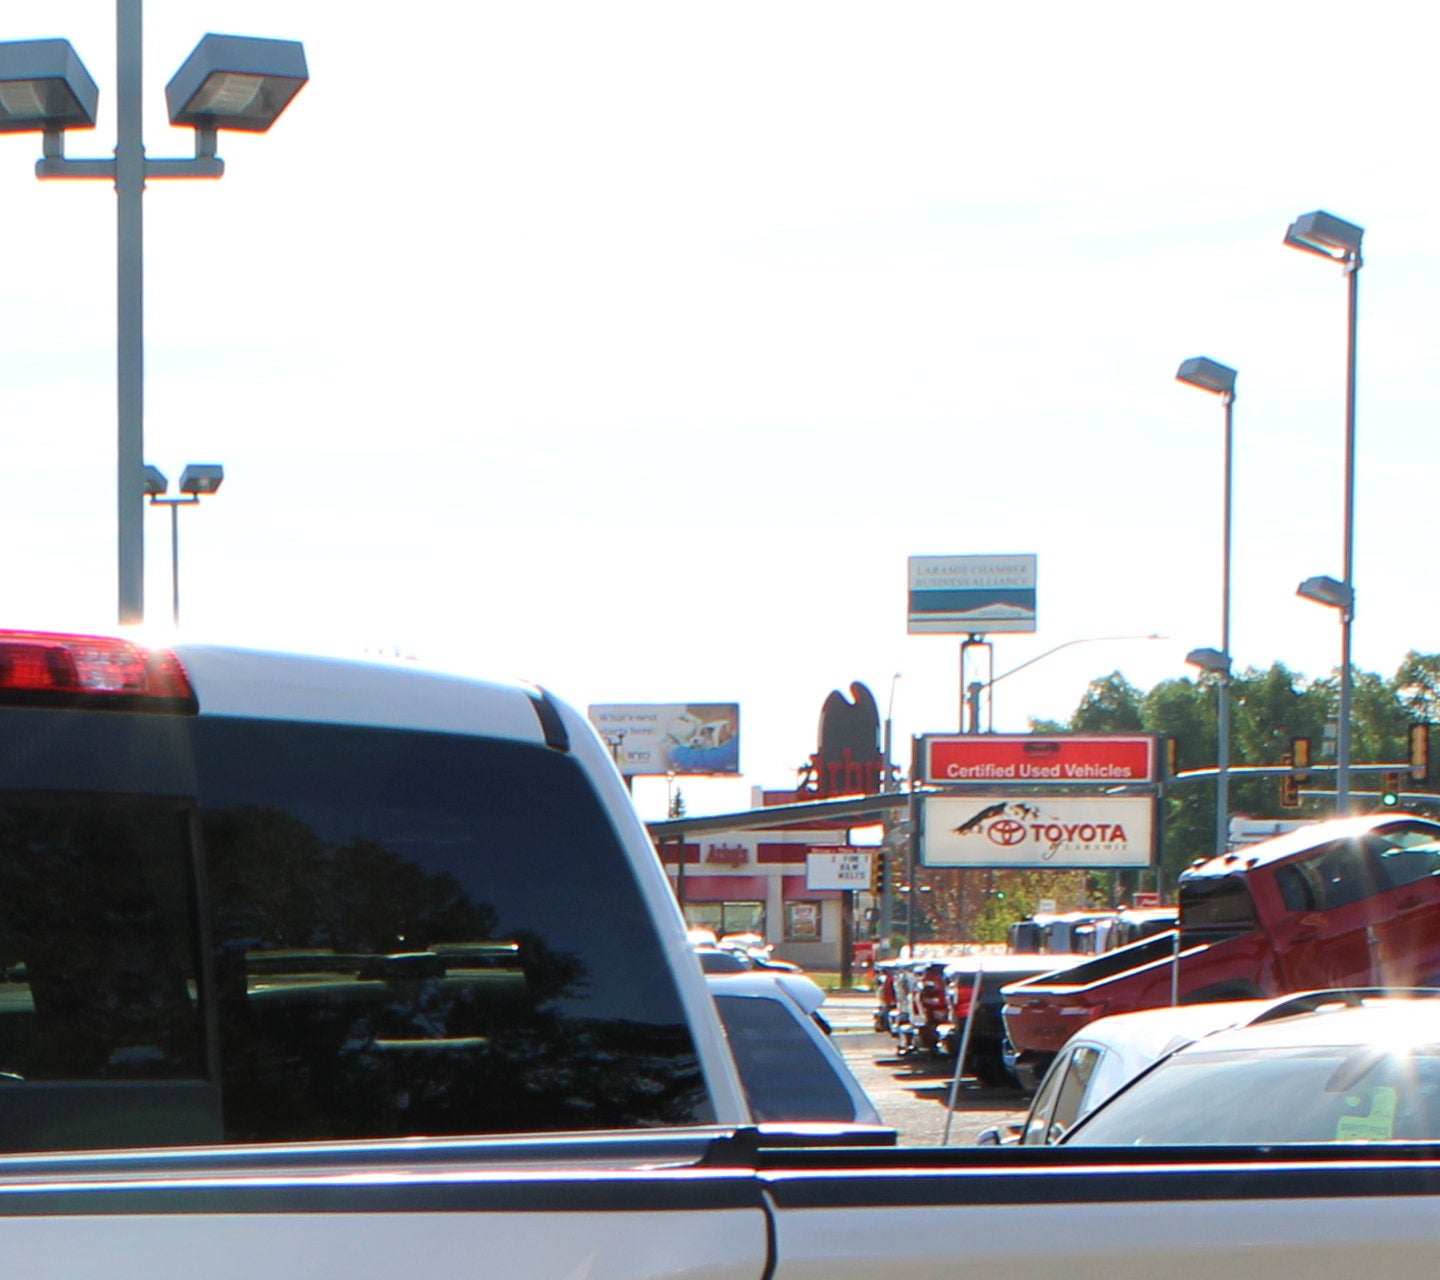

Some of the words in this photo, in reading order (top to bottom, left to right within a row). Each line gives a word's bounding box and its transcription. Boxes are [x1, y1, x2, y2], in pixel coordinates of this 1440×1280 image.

[947, 763, 1015, 778] Certified
[1020, 763, 1061, 778] Used
[1065, 763, 1132, 778] Vehicles
[1031, 823, 1128, 843] TOYOTA
[1065, 843, 1128, 851] LARAMIE
